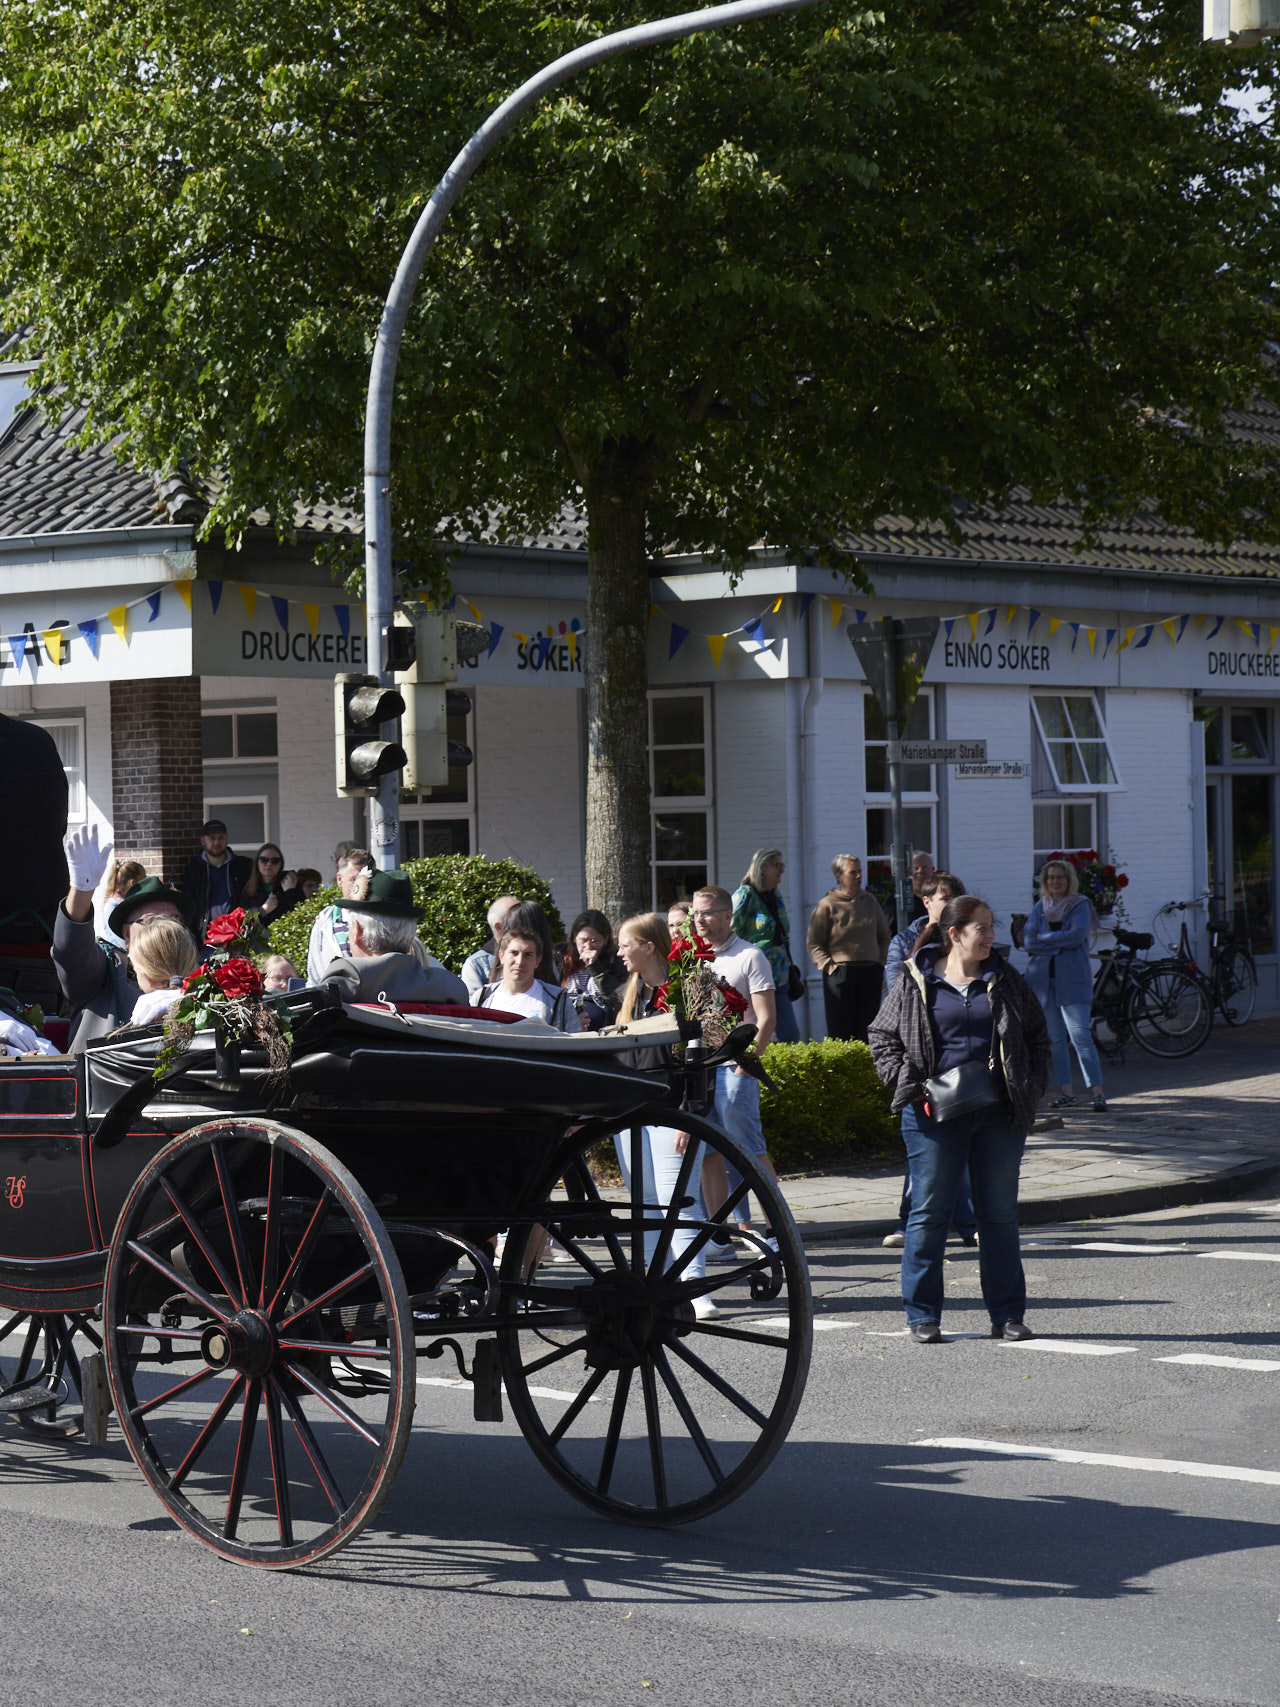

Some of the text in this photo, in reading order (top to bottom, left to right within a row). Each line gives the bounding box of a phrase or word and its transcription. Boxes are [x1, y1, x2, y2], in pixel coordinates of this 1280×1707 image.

[944, 639, 1051, 671] ENNO SÖKER
[1208, 651, 1280, 677] DRUCKERE
[901, 744, 985, 763] Marienkamper Straße
[1003, 762, 1022, 776] Straße
